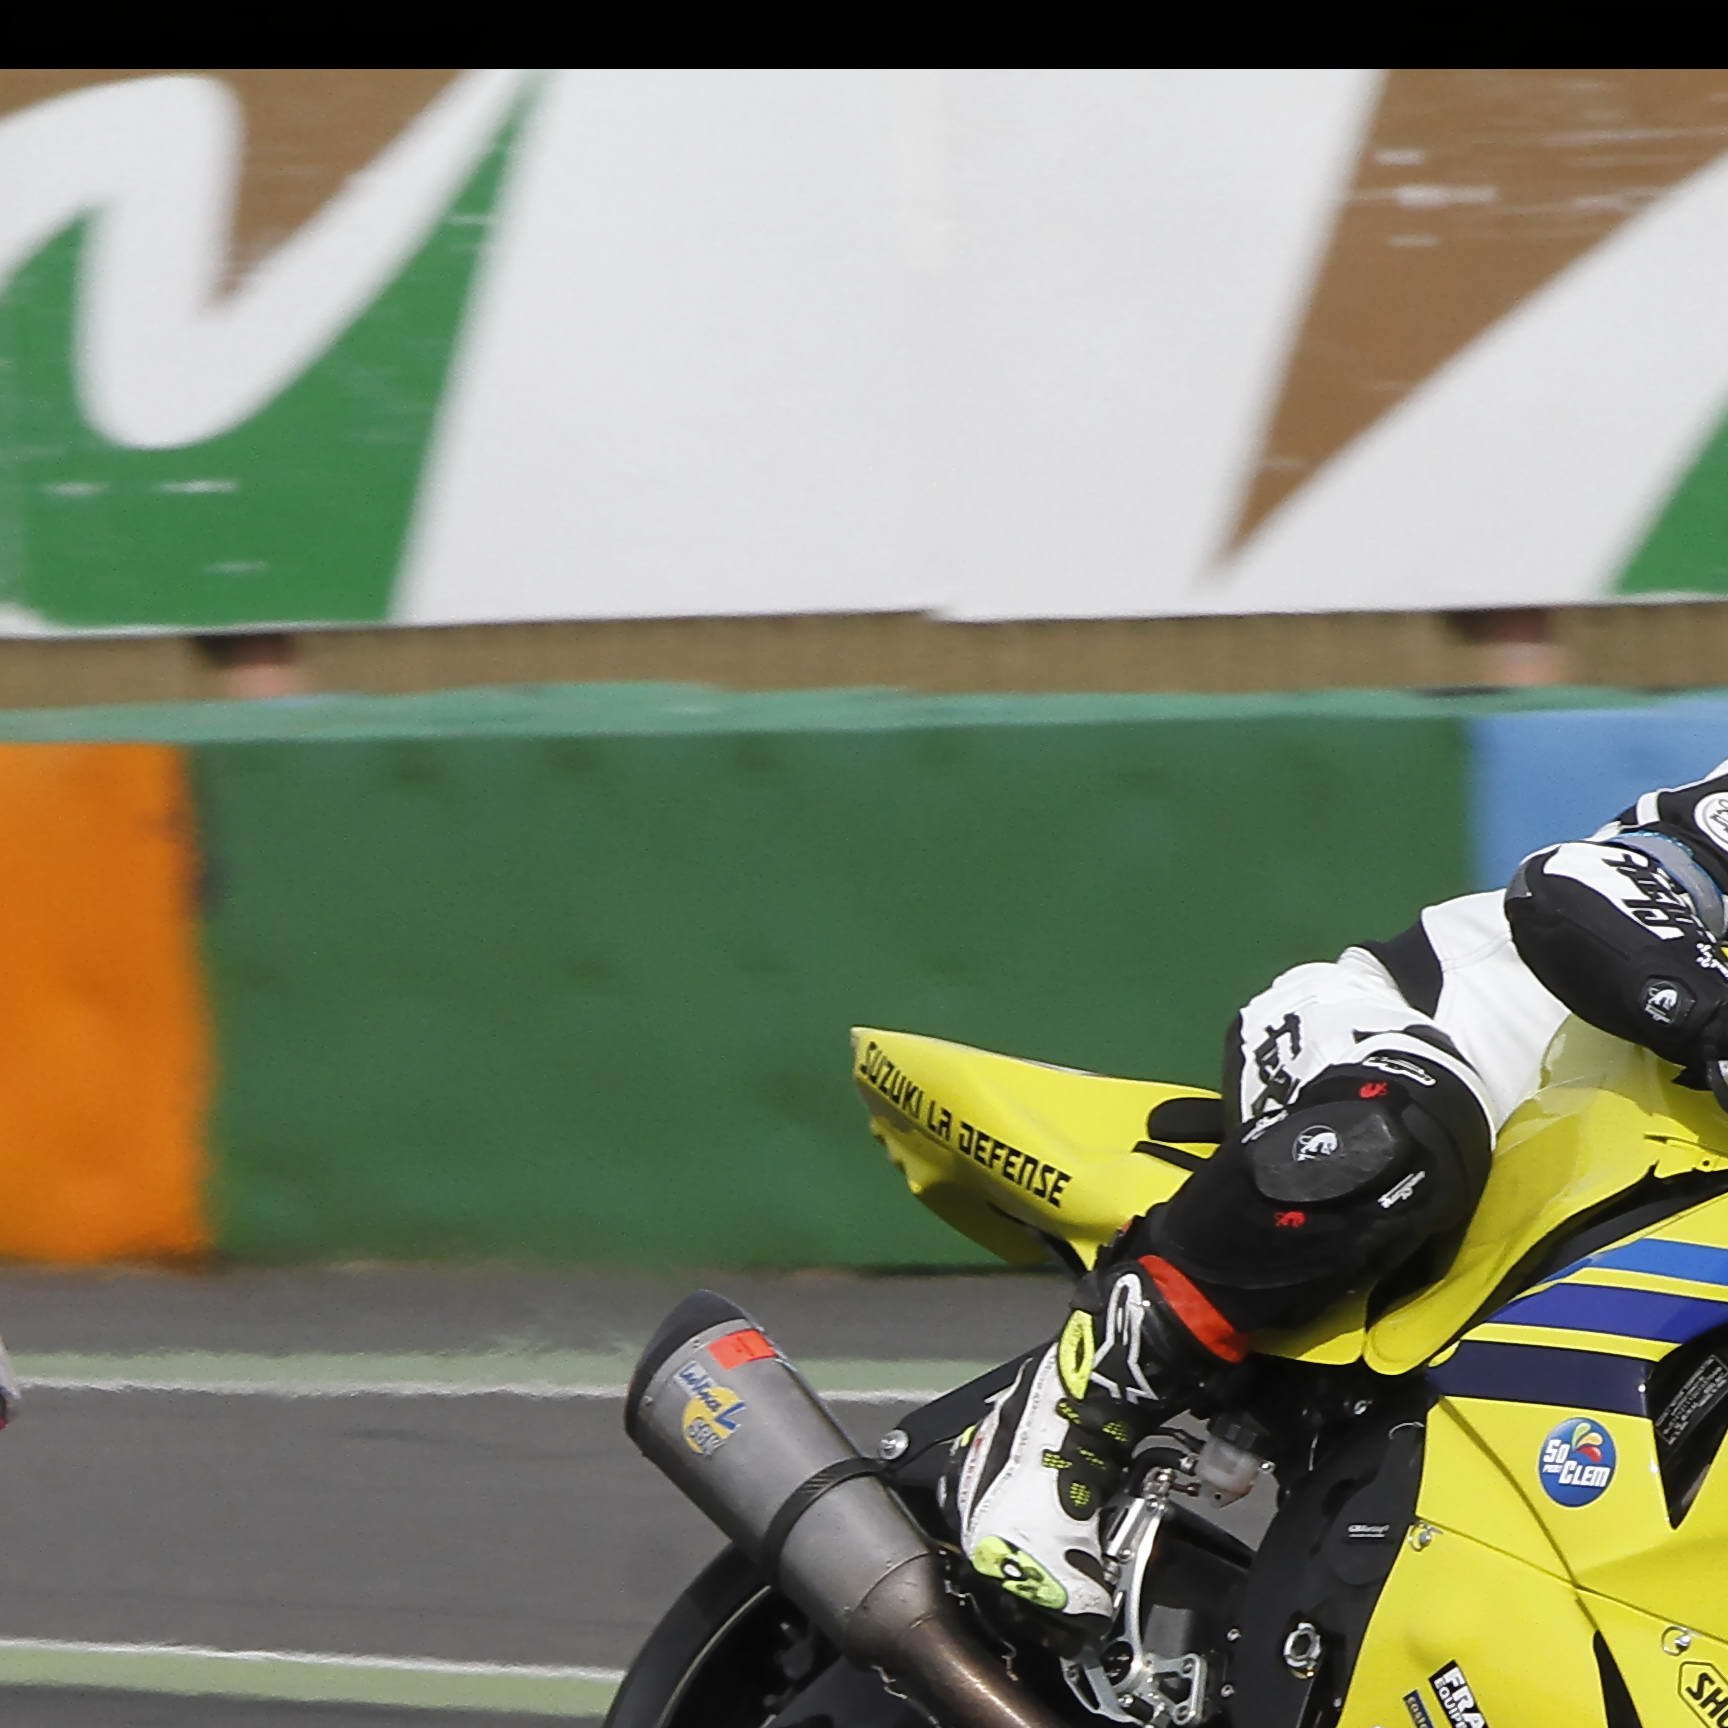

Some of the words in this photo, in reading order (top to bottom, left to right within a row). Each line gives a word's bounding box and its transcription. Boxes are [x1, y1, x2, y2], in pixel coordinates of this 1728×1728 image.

[860, 1041, 924, 1119] SUZUKI
[926, 1101, 953, 1141] LA
[958, 1120, 1072, 1208] DEFENSE
